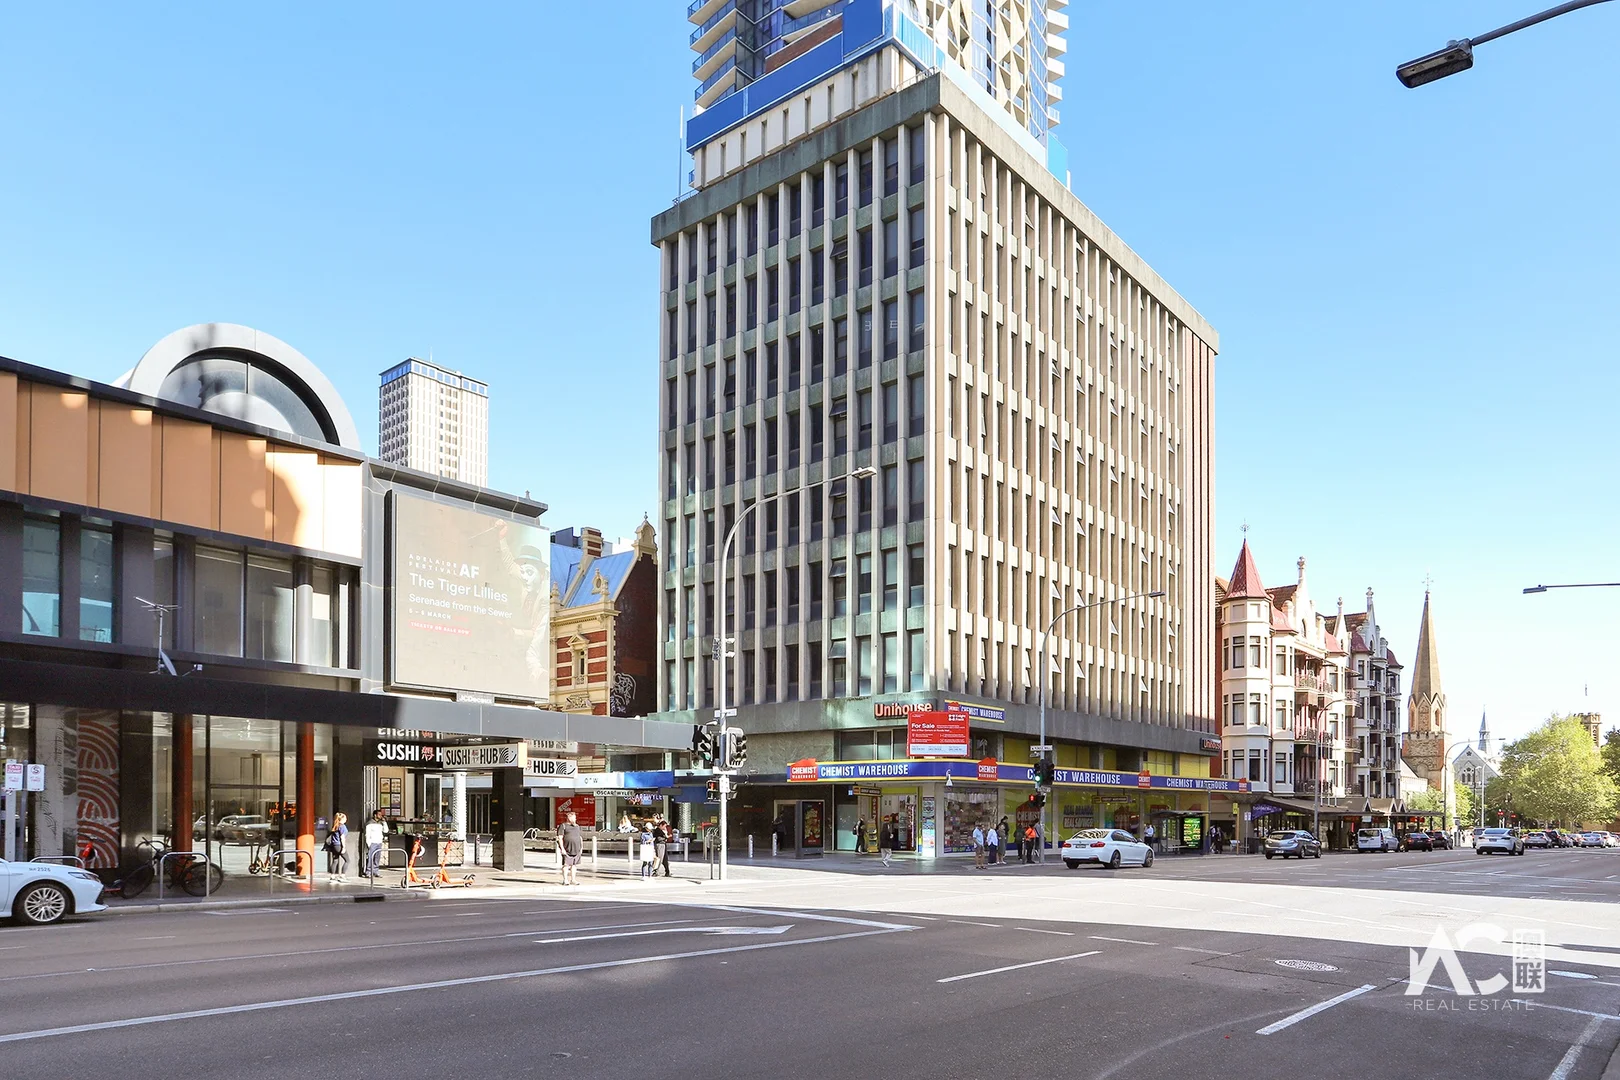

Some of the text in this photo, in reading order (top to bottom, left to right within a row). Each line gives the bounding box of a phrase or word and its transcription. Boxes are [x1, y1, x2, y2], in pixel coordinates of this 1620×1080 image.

[409, 553, 457, 568] ADELAIDE
[409, 561, 457, 576] FESTIVAL
[460, 563, 480, 579] AF
[409, 572, 508, 603] The Tiger Lillies
[409, 593, 513, 619] Serenade from the Sewer
[874, 702, 933, 717] Unihouse
[377, 742, 420, 761] SUSHI
[446, 748, 470, 766] SUSHI
[480, 748, 498, 764] HUB
[533, 760, 554, 774] HUB
[792, 766, 816, 774] CHEMIST
[820, 764, 908, 776] CHEMIST WAREHOUSE
[978, 765, 997, 774] CHEMIST
[1072, 772, 1120, 784] WAREHOUSE
[1166, 778, 1193, 788] CHEMIST
